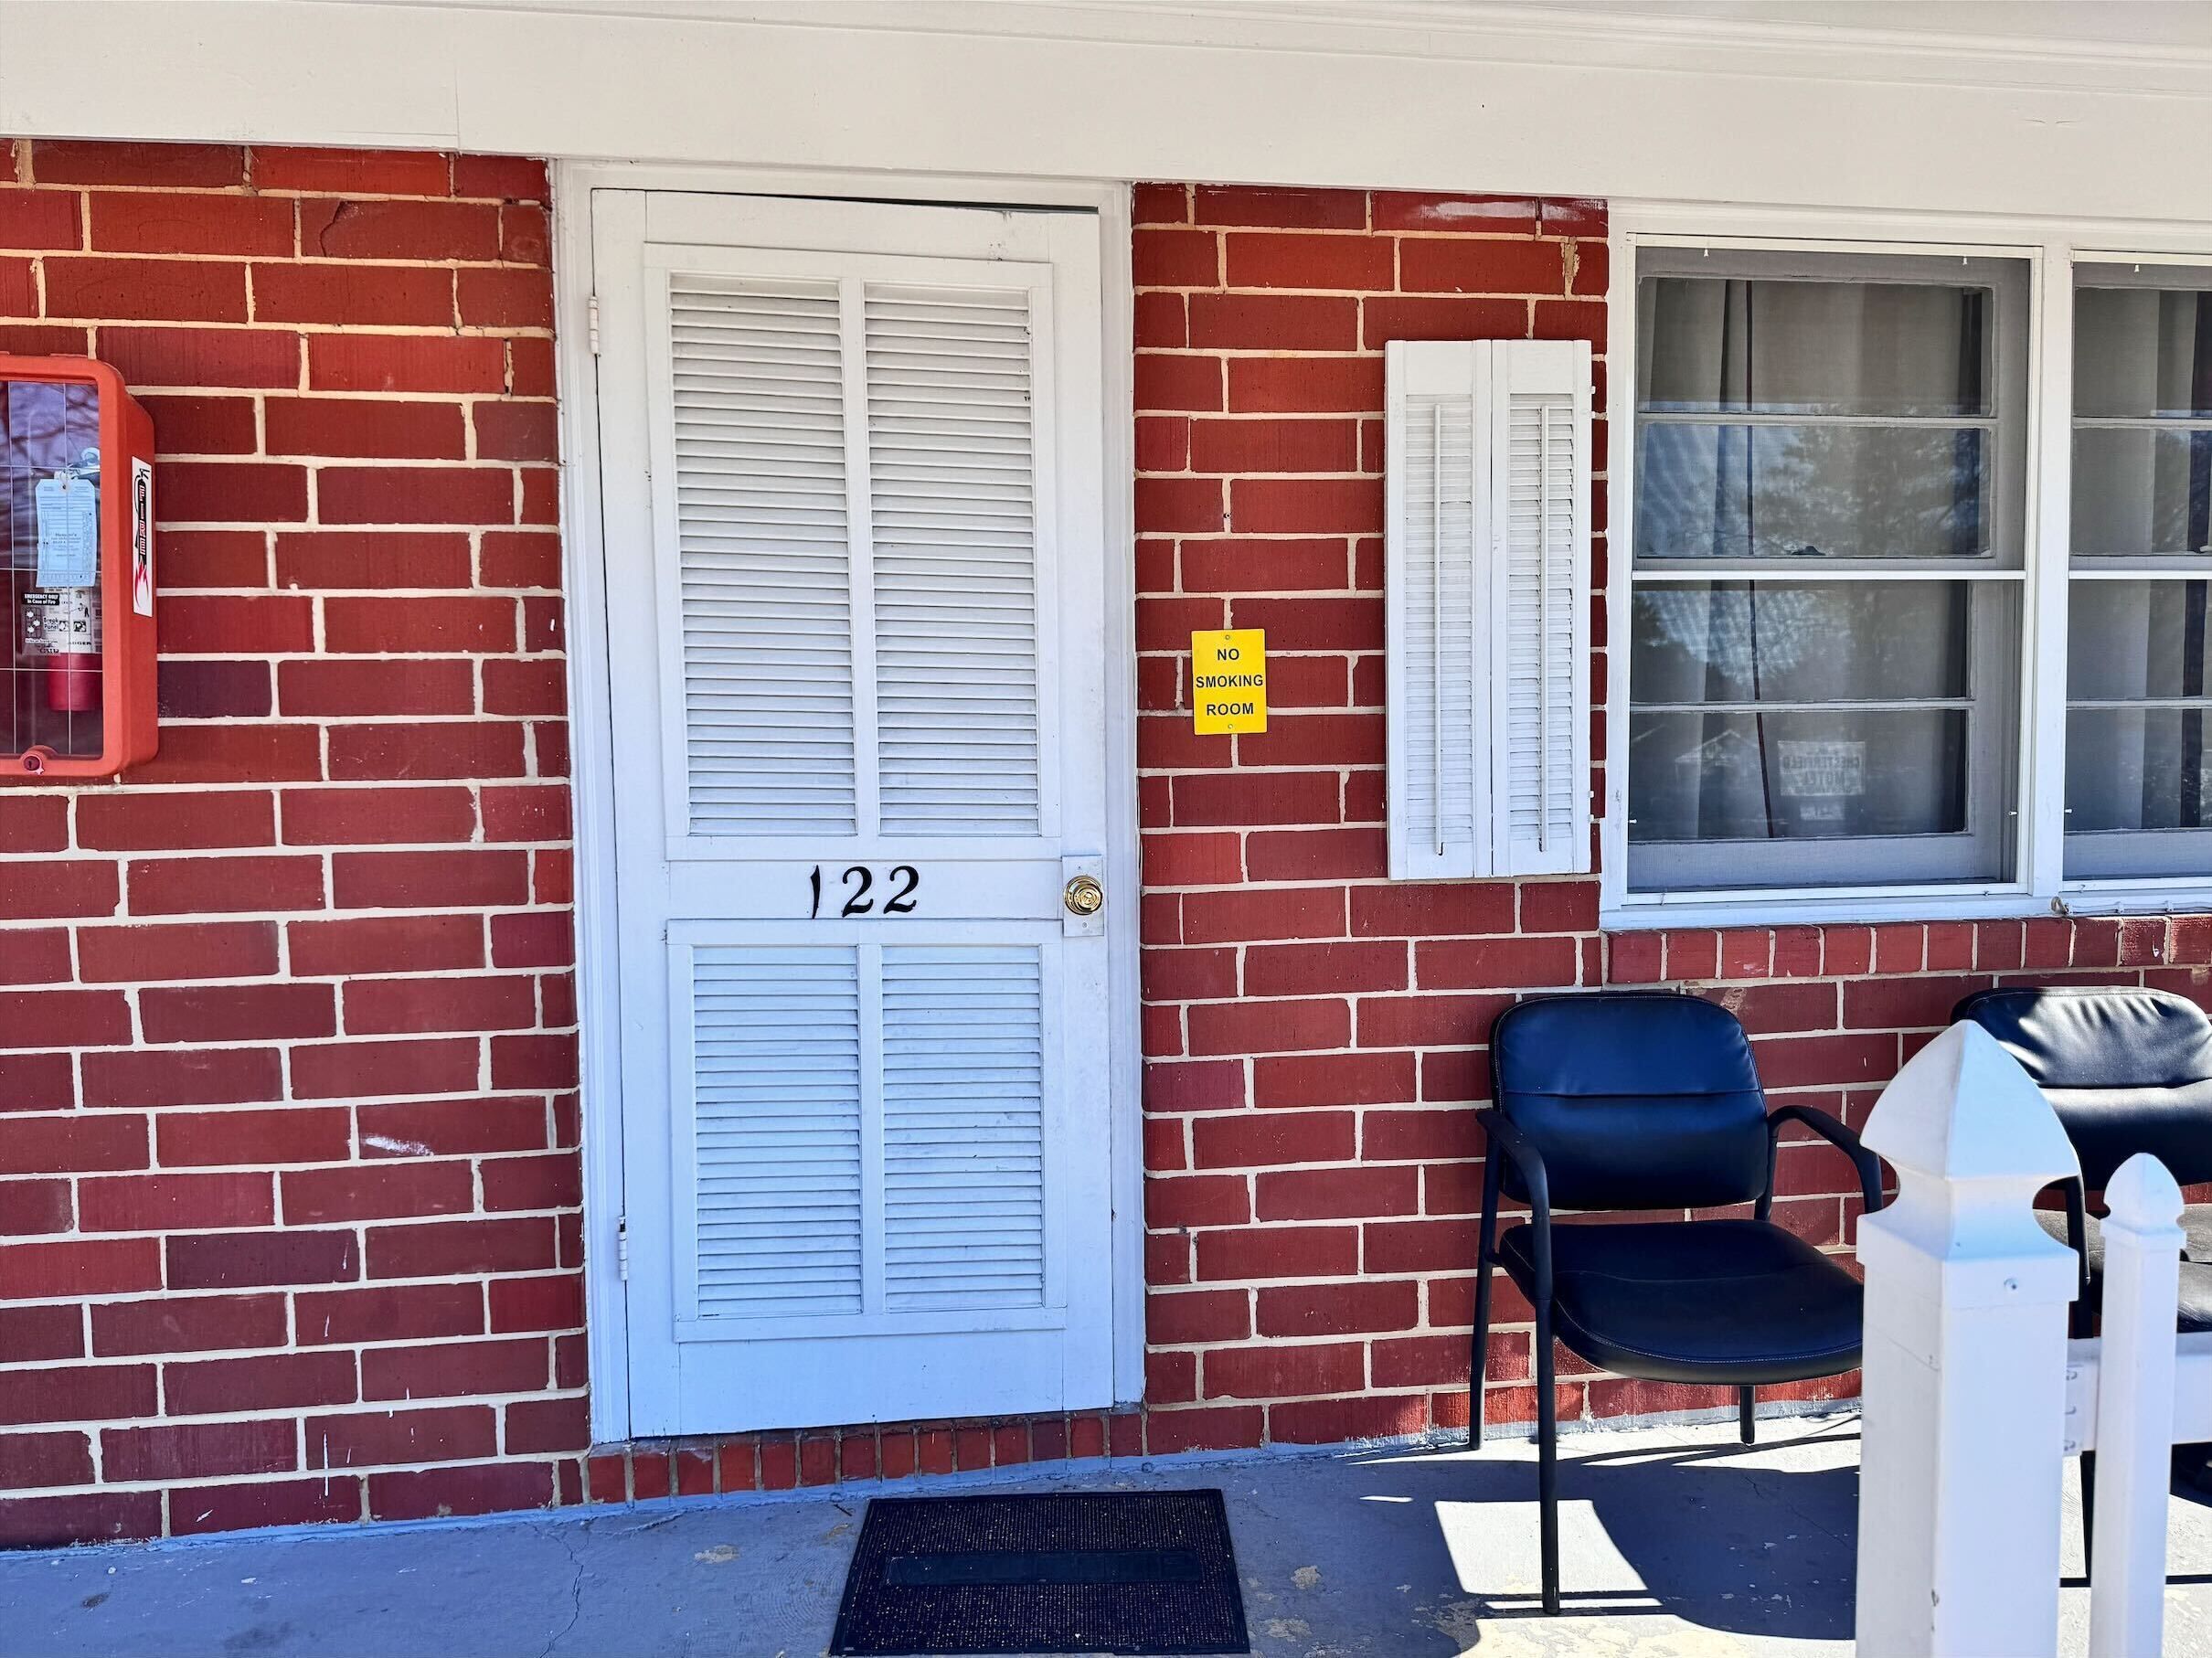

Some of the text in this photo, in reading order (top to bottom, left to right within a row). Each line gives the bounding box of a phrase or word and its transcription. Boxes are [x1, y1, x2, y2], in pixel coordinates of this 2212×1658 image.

[1217, 648, 1239, 661] NO
[1196, 675, 1263, 688] SMOKING
[1207, 703, 1254, 716] ROOM
[810, 864, 920, 920] 122
